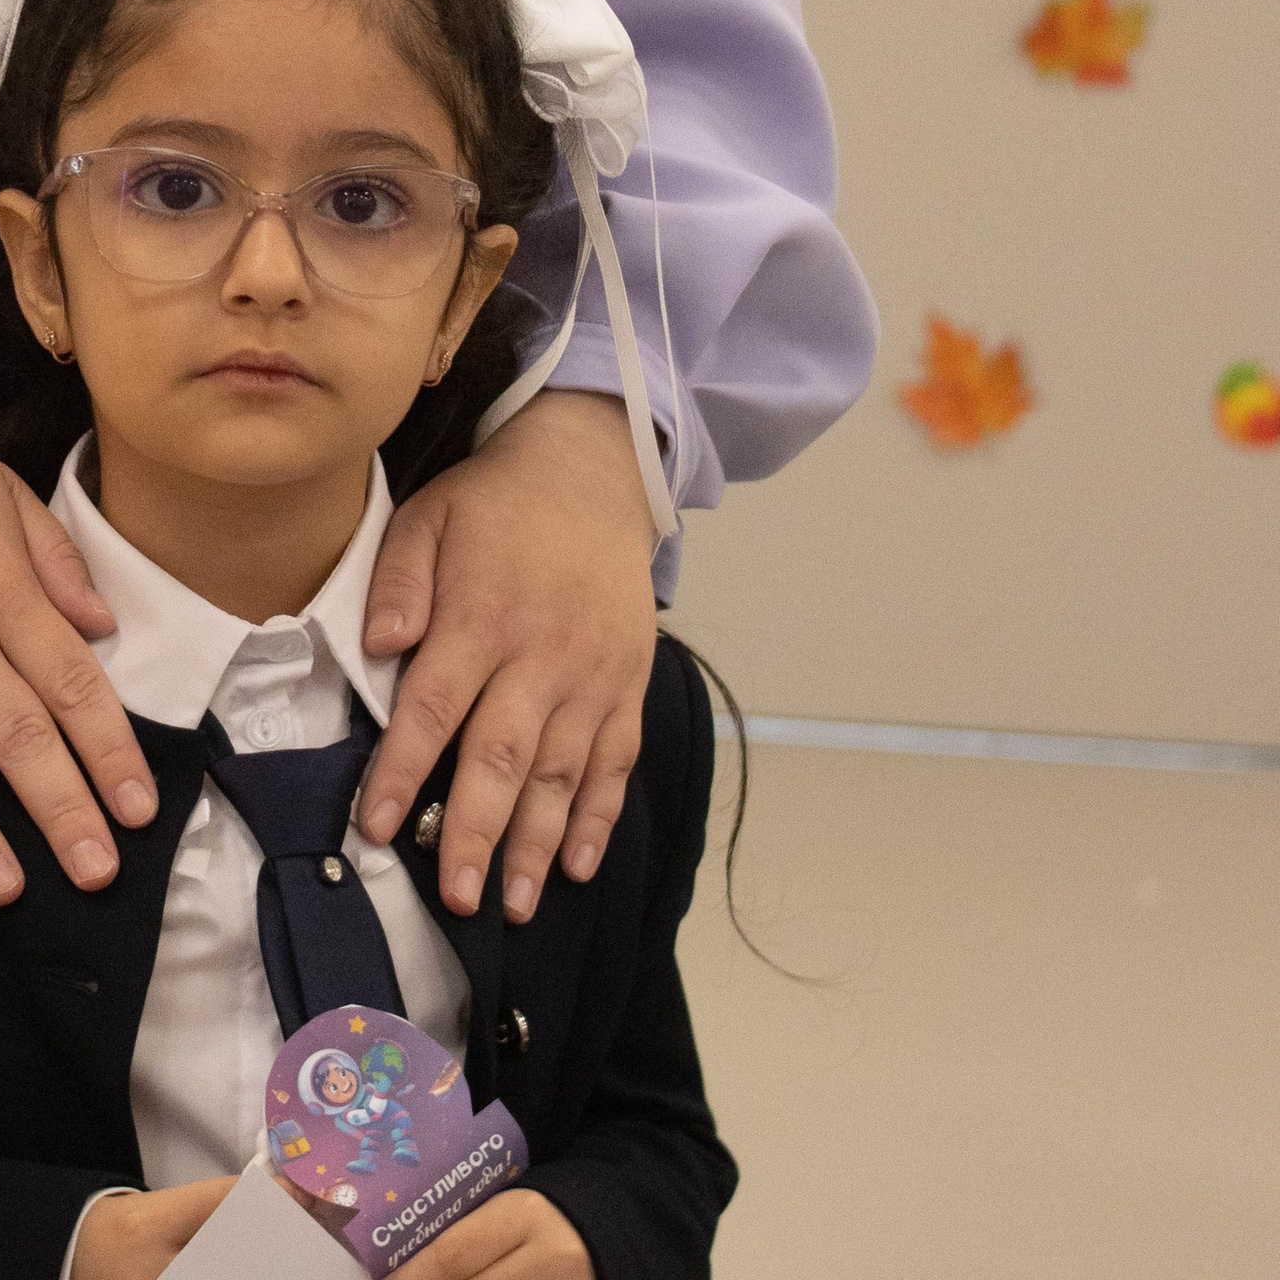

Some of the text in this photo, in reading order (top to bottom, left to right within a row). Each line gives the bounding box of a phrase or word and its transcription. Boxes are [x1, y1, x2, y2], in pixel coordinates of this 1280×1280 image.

[372, 1133, 504, 1247] Счастливого
[388, 1150, 512, 1269] учебного года!
